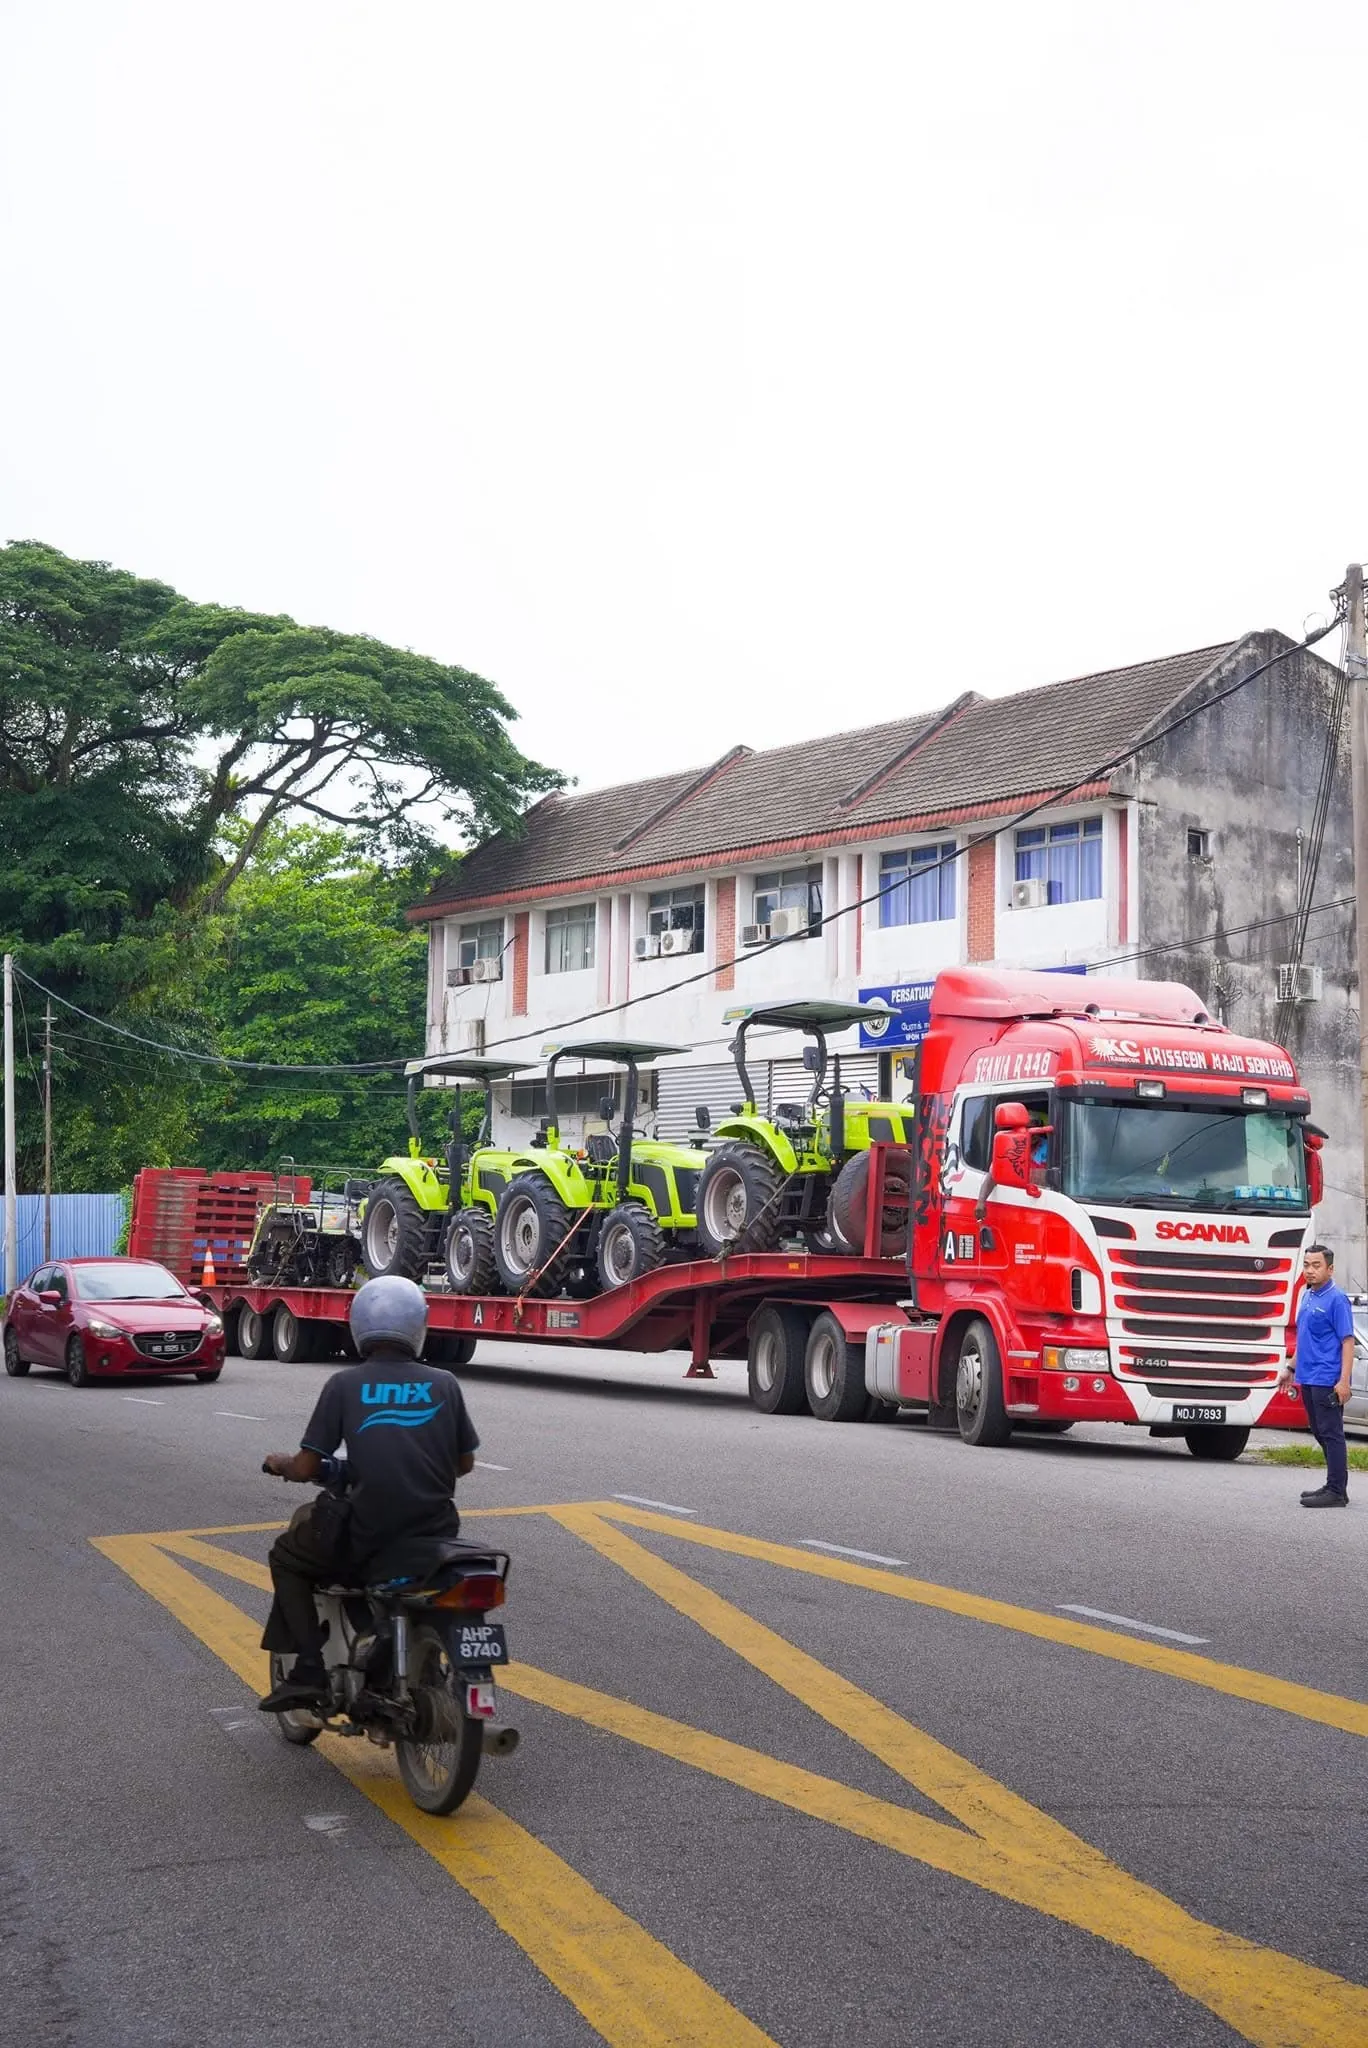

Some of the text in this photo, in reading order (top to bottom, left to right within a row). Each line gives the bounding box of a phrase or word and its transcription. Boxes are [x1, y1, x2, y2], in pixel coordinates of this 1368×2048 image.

[974, 1055, 1010, 1083] SCANIA
[1143, 1047, 1208, 1069] KRISSCON
[1155, 1221, 1250, 1244] SCANIA
[944, 1231, 955, 1260] A
[473, 1303, 483, 1325] A
[1145, 1359, 1168, 1367] 440
[1198, 1408, 1222, 1420] 7893
[462, 1627, 493, 1642] AHP
[460, 1643, 502, 1657] 8740
[470, 1688, 494, 1716] L
